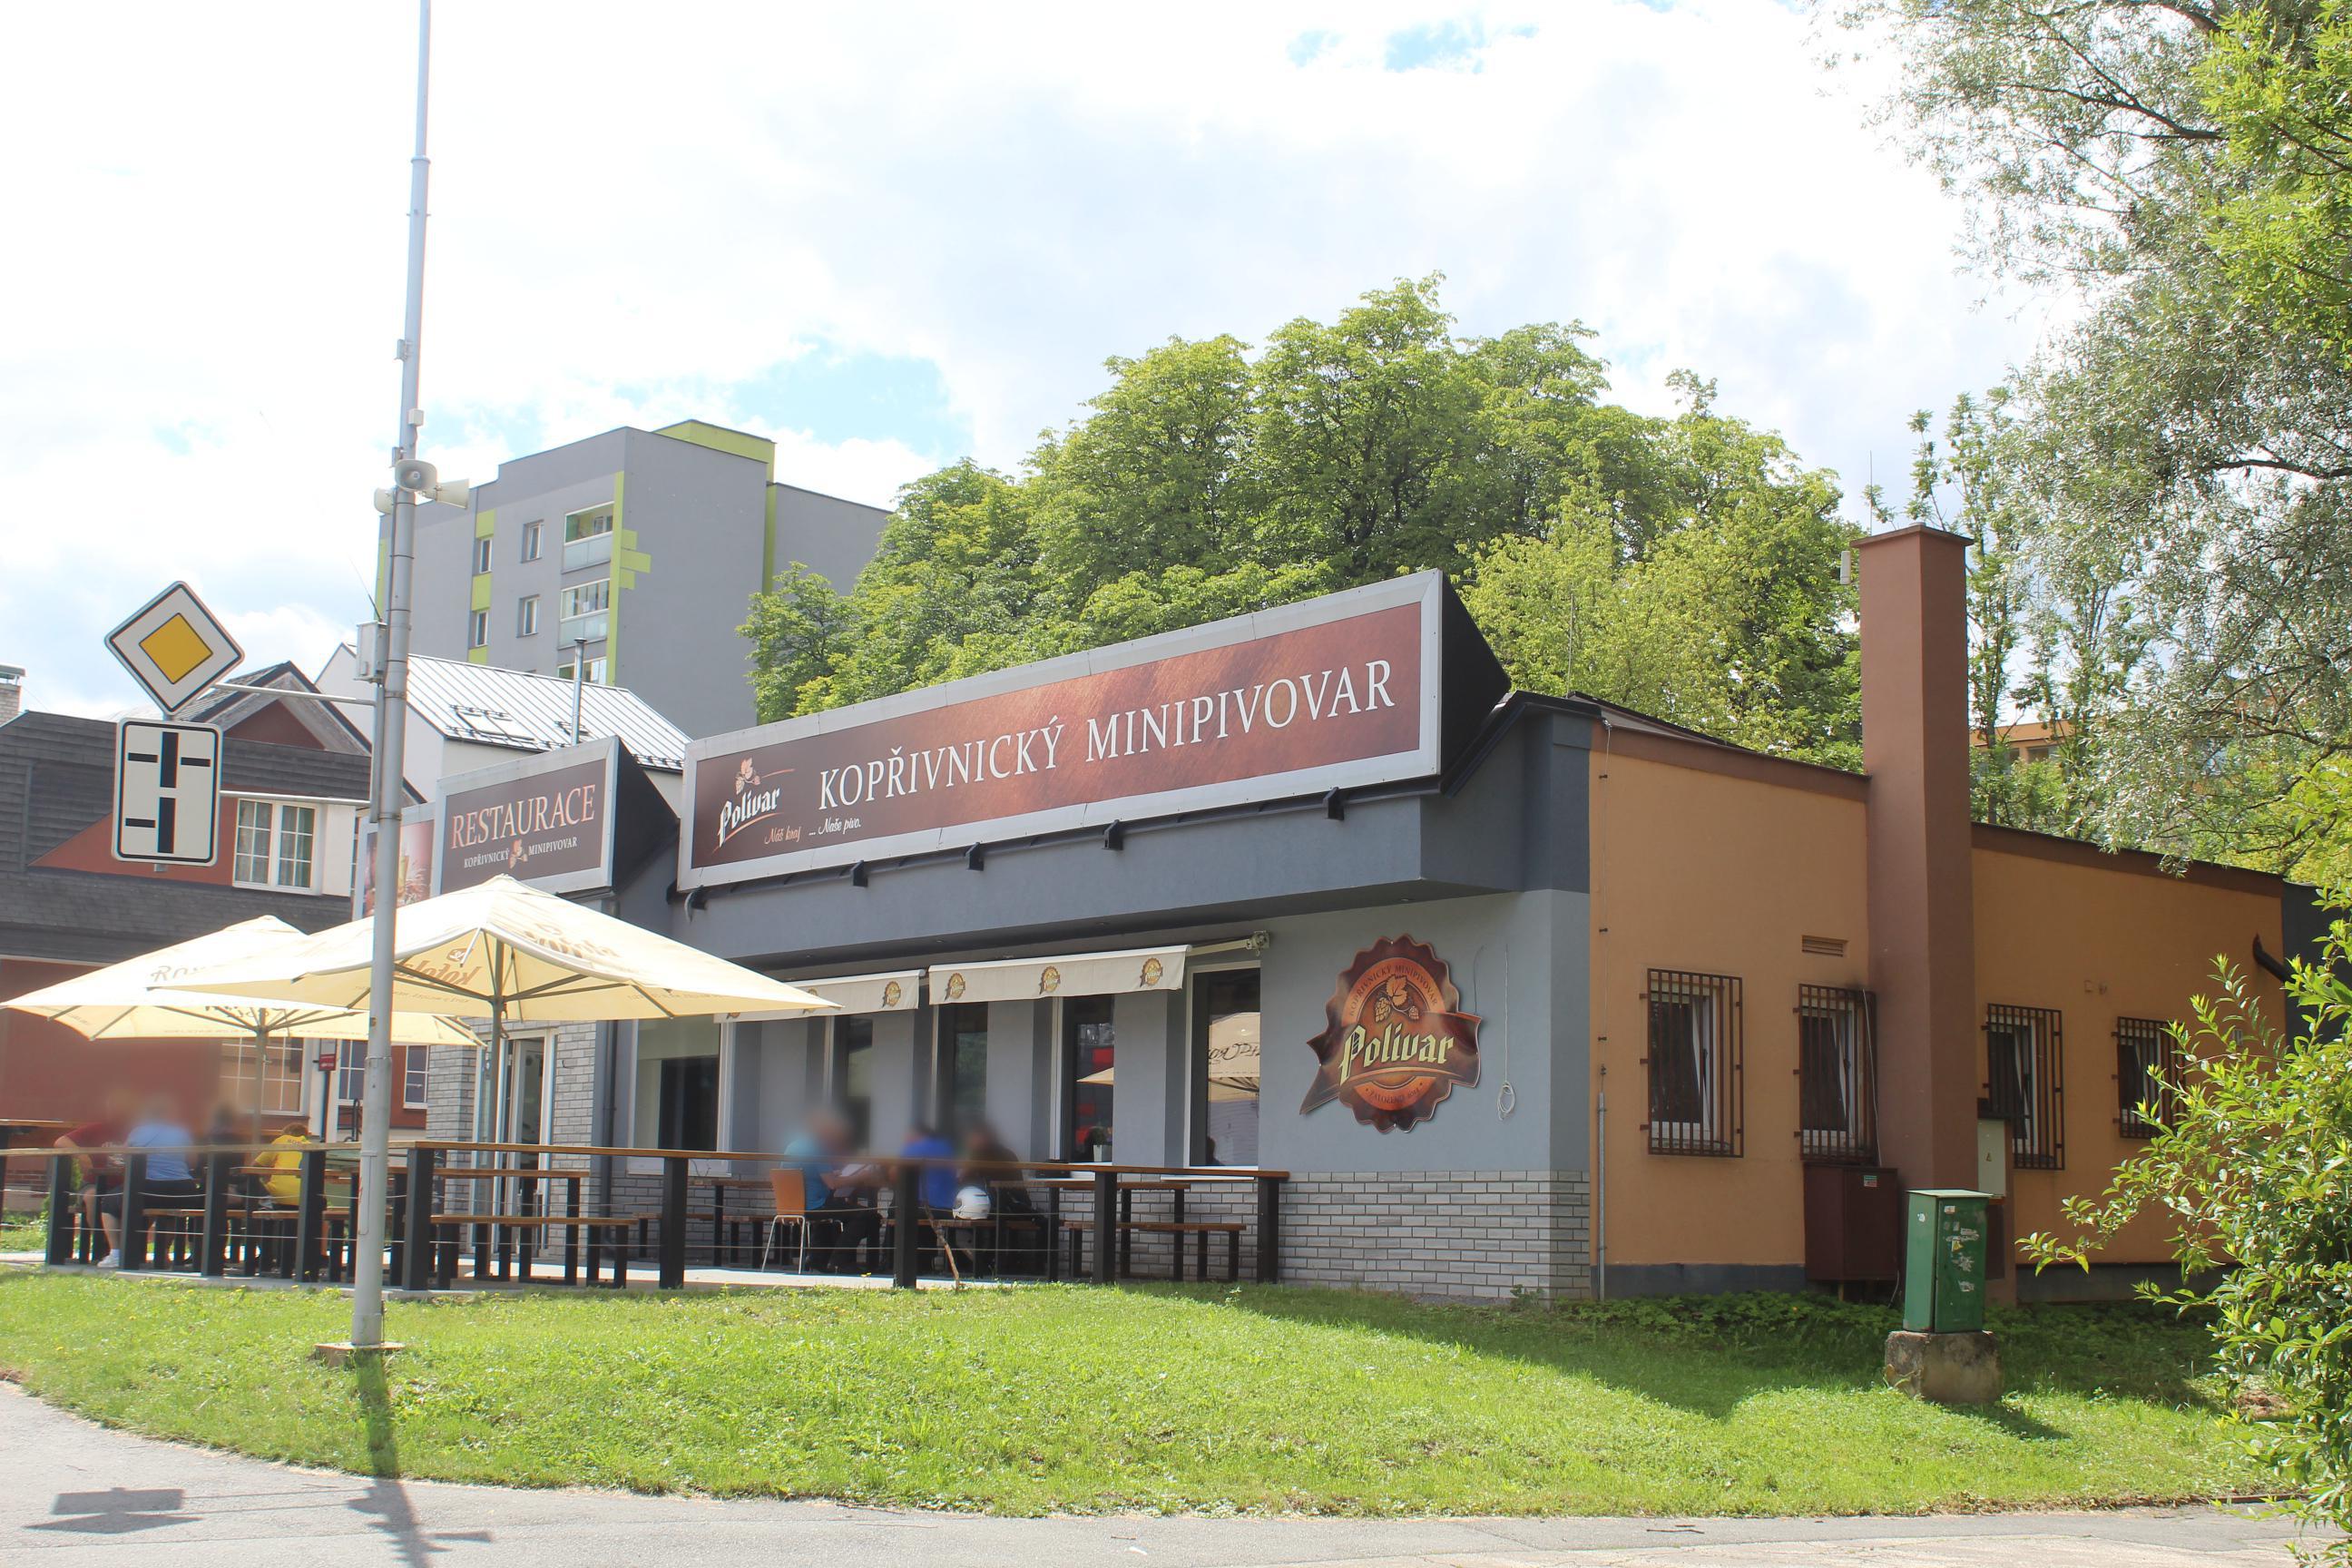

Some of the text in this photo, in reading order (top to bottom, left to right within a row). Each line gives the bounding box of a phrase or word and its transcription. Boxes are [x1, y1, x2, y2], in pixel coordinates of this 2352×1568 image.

[818, 660, 1395, 810] KOPŘIVNICKÝ MINIPIVOVAR
[450, 784, 596, 849] RESTAURACE
[464, 837, 578, 868] KOPŘIVNICKÝ MINIPIVOVAR
